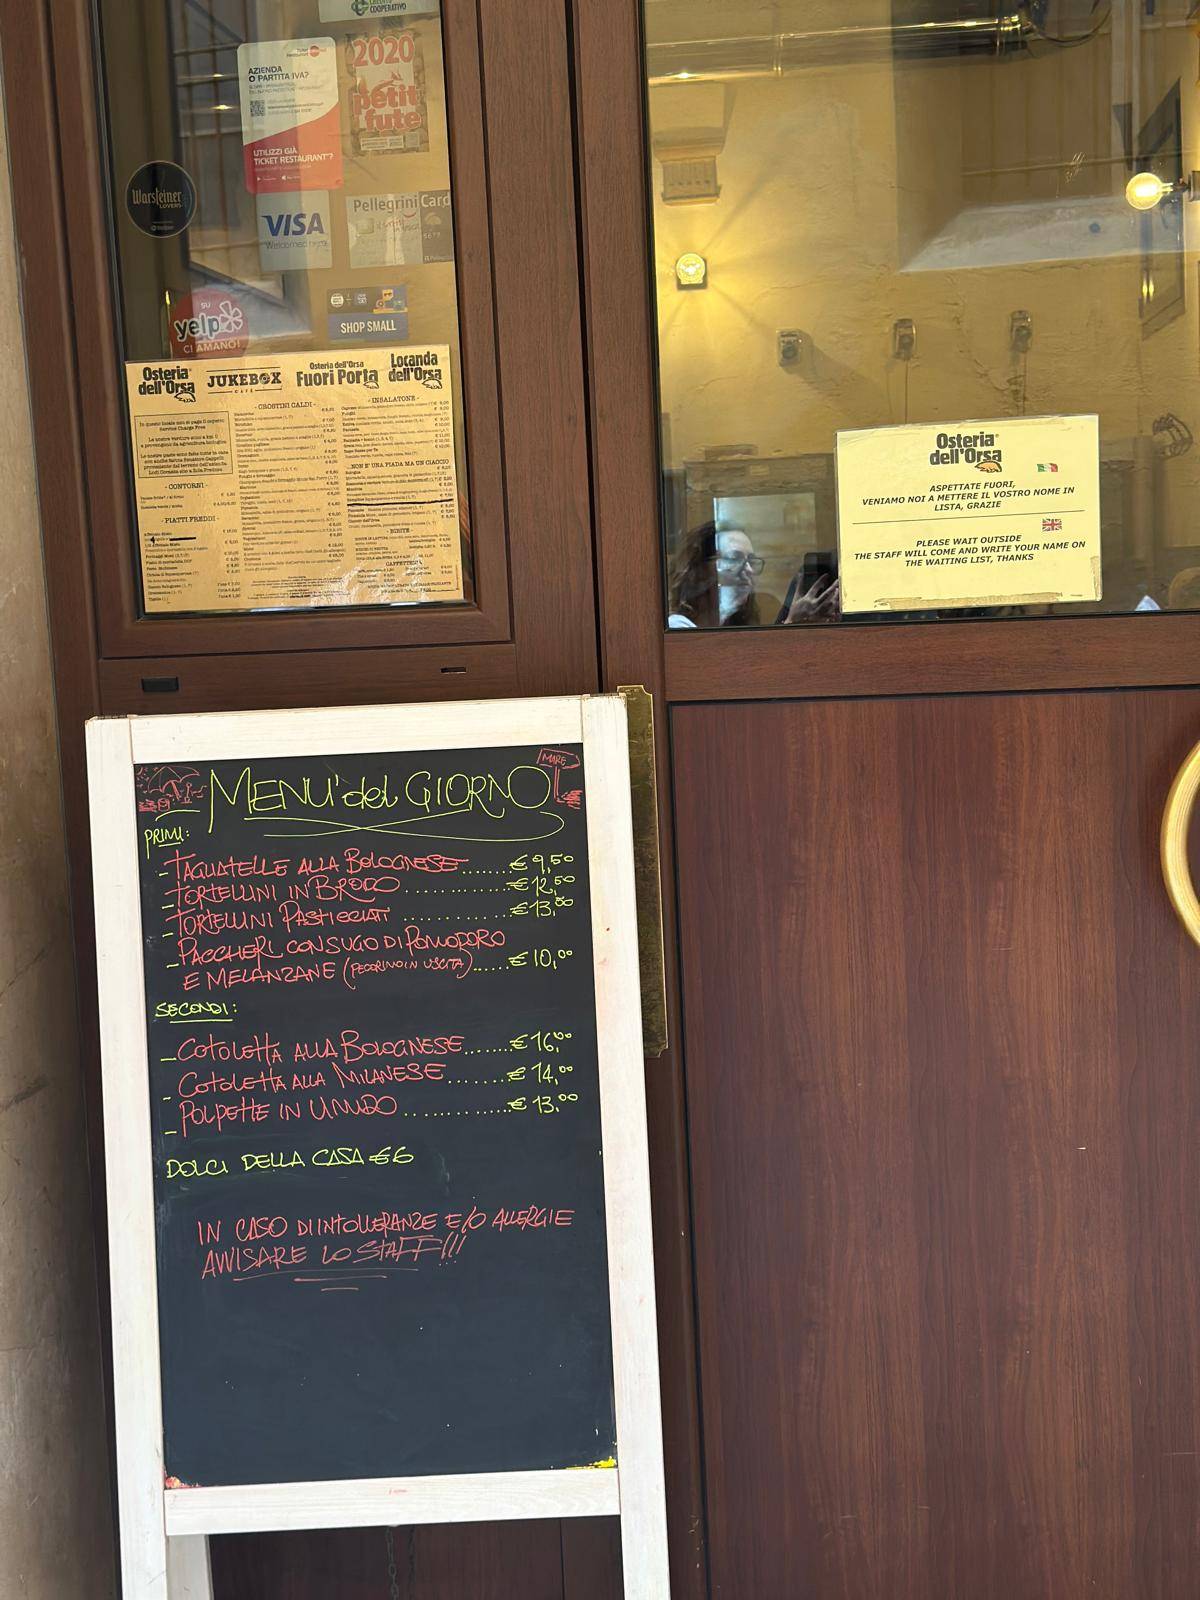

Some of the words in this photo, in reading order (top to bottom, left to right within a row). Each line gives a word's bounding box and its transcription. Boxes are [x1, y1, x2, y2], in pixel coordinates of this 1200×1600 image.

[352, 34, 415, 68] 2020
[248, 66, 283, 75] AZIENDA
[248, 75, 256, 83] O
[257, 73, 290, 82] PARTITA
[292, 71, 310, 81] IVA?
[253, 148, 283, 157] UTILIZZI
[284, 146, 298, 155] GIÀ
[254, 157, 278, 165] TICKET
[131, 187, 183, 205] Warsteiner
[353, 195, 418, 213] Pellegrini
[421, 193, 450, 208] Card
[261, 212, 325, 237] VISA
[174, 314, 221, 342] yelp
[340, 321, 365, 335] SHOP
[366, 319, 397, 332] SMALL
[183, 344, 193, 354] CI
[195, 340, 241, 353] AMANO!
[309, 362, 338, 370] Osteria
[340, 361, 365, 369] dell'Orsa
[391, 352, 438, 368] Locanda
[143, 365, 189, 381] Osteria
[207, 371, 282, 388] JUKEBOX
[296, 370, 336, 388] Fuori
[338, 366, 379, 386] Porta
[388, 366, 442, 384] dell'Orsa
[138, 379, 196, 395] dell'Orsa
[291, 401, 313, 409] CALDI
[936, 431, 995, 449] Osteria
[929, 448, 1002, 466] dell'Orsa
[168, 482, 204, 490] CONTORNI
[929, 482, 981, 492] ASPETTATE
[983, 480, 1016, 490] FUORI,
[862, 496, 905, 506] VENIAMO
[907, 495, 926, 504] NOI
[927, 494, 935, 502] A
[937, 491, 978, 501] METTERE
[981, 491, 991, 500] IL
[993, 489, 1031, 498] VOSTRO
[1033, 487, 1061, 496] NOME
[1063, 486, 1075, 495] IN
[934, 502, 964, 512] LISTA,
[966, 500, 1001, 510] GRAZIE
[916, 538, 950, 547] PLEASE
[952, 536, 978, 546] WAIT
[980, 534, 1022, 544] OUTSIDE
[854, 552, 872, 561] THE
[873, 550, 902, 560] STAFF
[904, 549, 929, 558] WILL
[930, 547, 956, 556] COME
[958, 545, 979, 555] AND
[981, 544, 1012, 554] WRITE
[1014, 542, 1041, 552] YOUR
[1042, 541, 1070, 550] NAME
[1071, 540, 1086, 549] ON
[905, 558, 922, 567] THE
[925, 556, 968, 566] WAITING
[970, 555, 994, 566] LIST,
[996, 553, 1034, 563] THANKS
[405, 765, 551, 819] GIORNO
[297, 856, 340, 875] ALLA
[164, 881, 277, 910] TORTELLINI
[308, 875, 401, 902] BRODO
[165, 908, 274, 938] TORTELLINI
[177, 936, 283, 970] PACCHERI
[287, 935, 325, 955] CON
[326, 934, 379, 955] SUGO
[384, 935, 403, 949] DI
[404, 925, 506, 957] POMODORO
[183, 971, 200, 991] E
[206, 961, 336, 990] MELANZANE
[155, 1002, 238, 1018] SECONDI:
[294, 1038, 339, 1062] ALLA
[341, 1029, 465, 1064] BOLOGNESE
[292, 1071, 326, 1090] ALLA
[331, 1062, 447, 1089] MILANESE
[279, 1102, 301, 1121] IN
[166, 1158, 229, 1179] DOLCI
[241, 1150, 306, 1172] DELLA
[311, 1147, 365, 1167] CASA
[198, 1219, 221, 1246] IN
[236, 1216, 288, 1242] CASO
[444, 1205, 487, 1233] E/O
[492, 1204, 576, 1232] ALLERGIE
[202, 1246, 308, 1280] AVVISARE
[321, 1245, 352, 1264] LO
